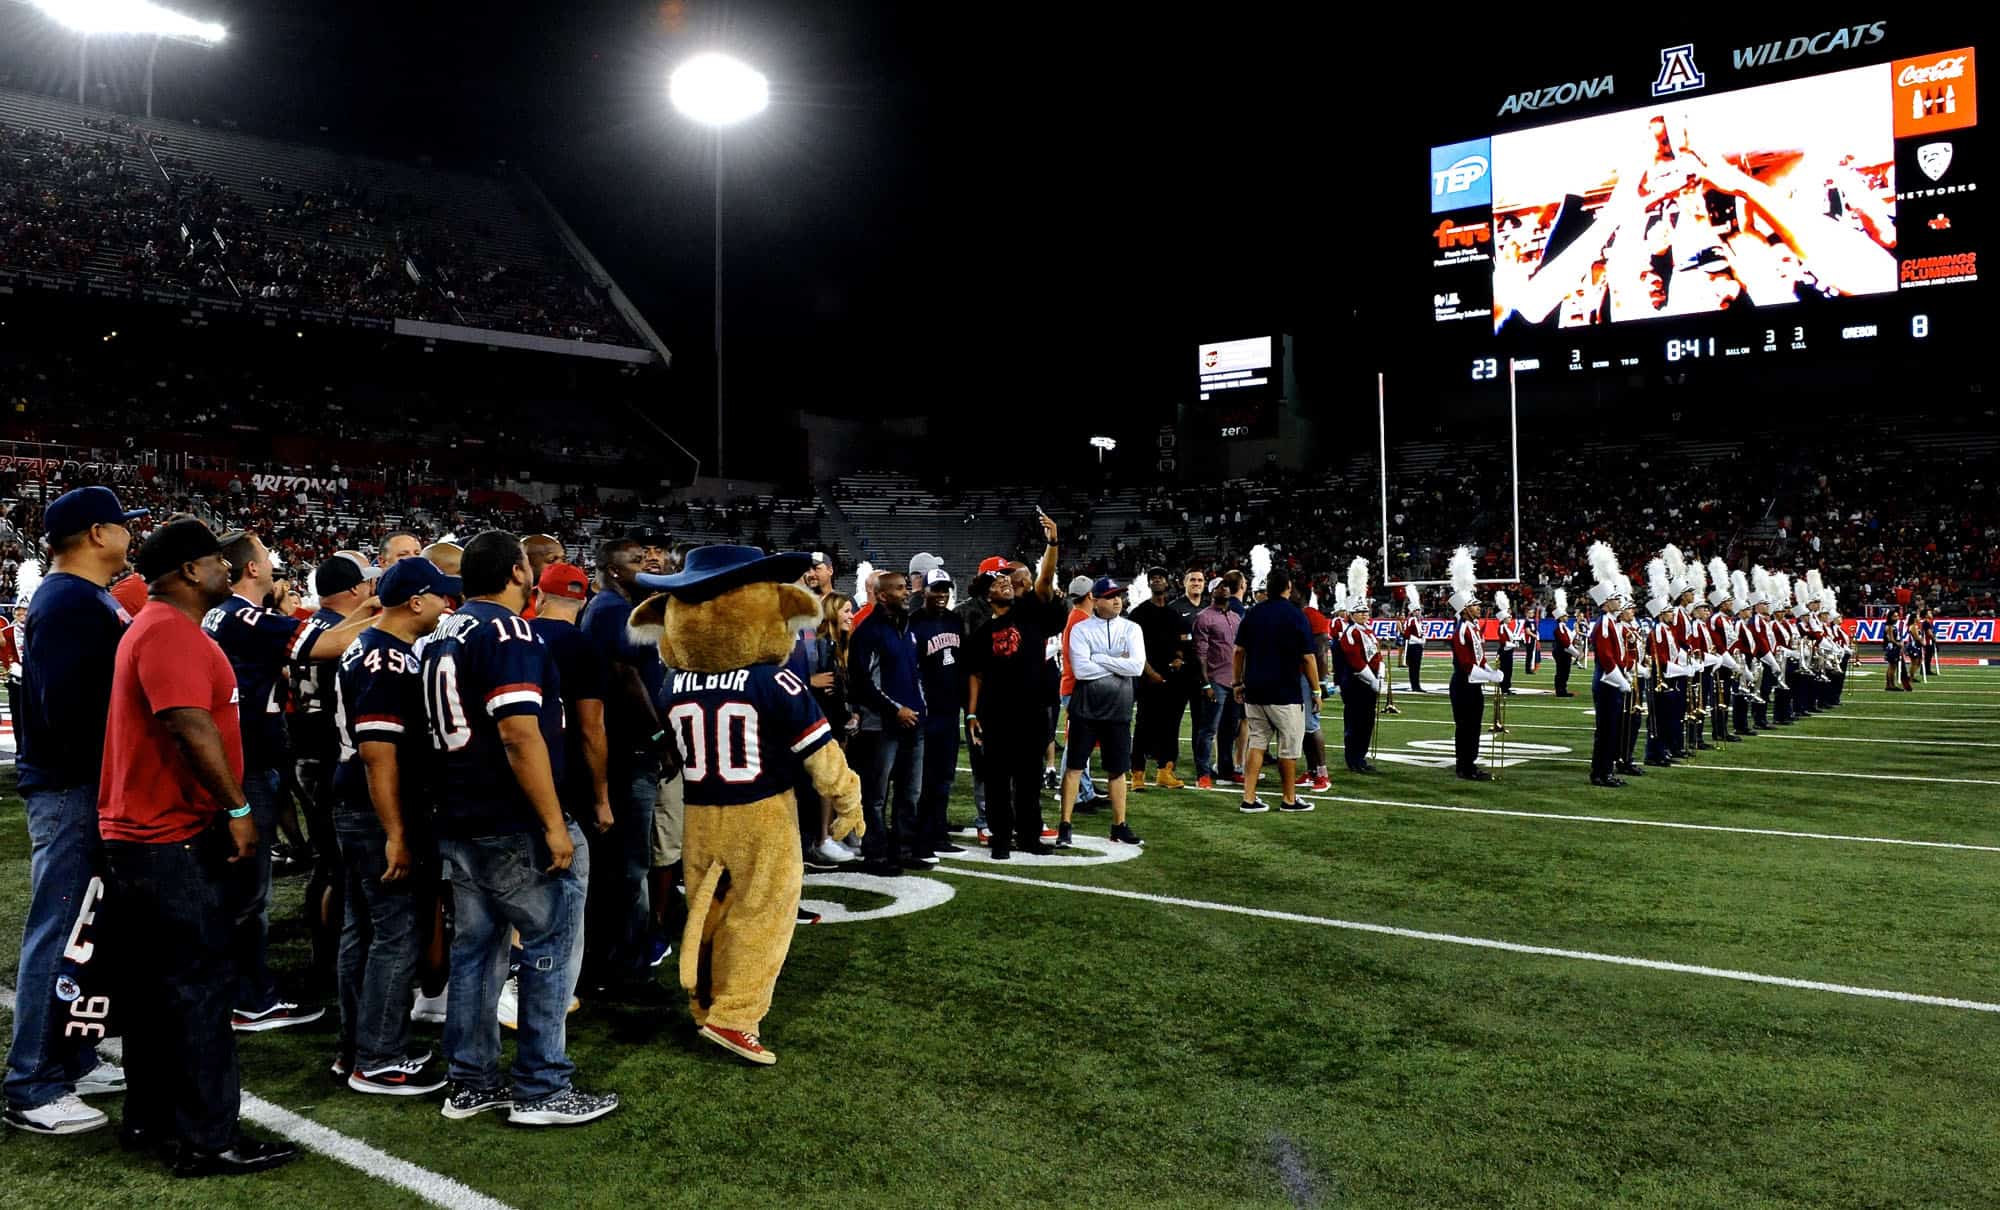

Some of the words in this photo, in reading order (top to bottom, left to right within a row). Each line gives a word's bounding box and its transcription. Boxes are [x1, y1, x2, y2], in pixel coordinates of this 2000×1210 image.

[1732, 20, 1887, 71] WILDCATS
[1652, 43, 1705, 97] A
[1497, 75, 1615, 117] ARIZONA
[1433, 155, 1489, 195] TEP
[1896, 182, 1977, 200] NETWORKS
[1900, 263, 1977, 282] PLUMBING
[1901, 252, 1977, 271] CUMMINGS
[1765, 329, 1775, 344] 3
[1793, 326, 1804, 341] 3
[1842, 325, 1878, 339] OREGON
[1912, 315, 1928, 338] 8
[1571, 349, 1581, 363] 3
[1666, 336, 1715, 361] 8:41
[1471, 358, 1497, 380] 23
[1221, 425, 1249, 437] zero
[251, 473, 337, 494] ARIZONA
[491, 614, 532, 643] 10
[1932, 619, 1995, 642] ERA
[672, 668, 750, 694] WILBUR
[668, 702, 762, 783] 00
[64, 995, 110, 1039] 36
